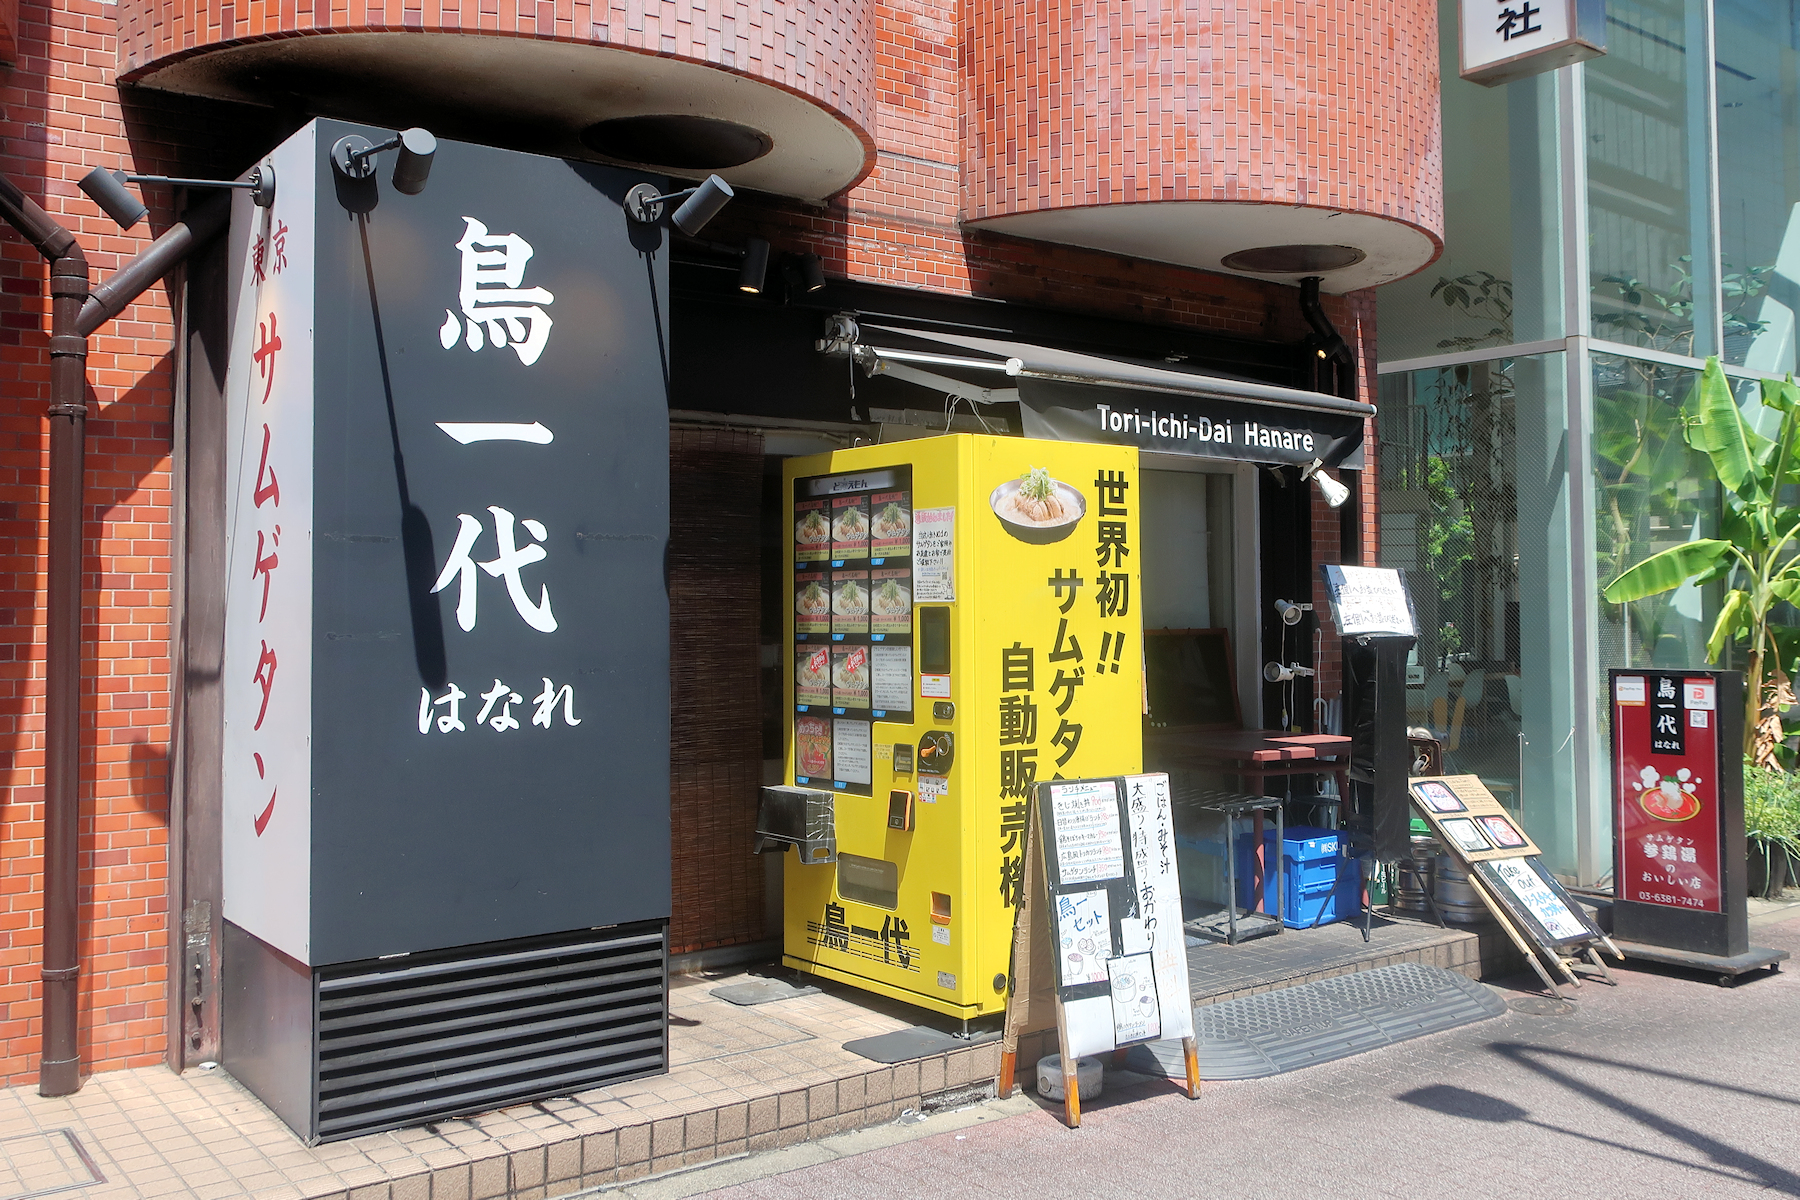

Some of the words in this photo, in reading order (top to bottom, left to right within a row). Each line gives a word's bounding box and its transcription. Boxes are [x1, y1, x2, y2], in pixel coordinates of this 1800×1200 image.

[1496, 0, 1542, 42] 社
[251, 219, 289, 287] 東京
[430, 216, 557, 634] 鳥一代
[1097, 404, 1232, 444] Tori-Ichi-Dai
[1244, 421, 1315, 452] Hanare
[833, 478, 868, 491] どえもん
[252, 311, 283, 838] サムゲタン
[1047, 568, 1085, 780] サムゲタ
[418, 678, 583, 736] はなれ
[1657, 677, 1678, 735] 鳥一代
[1654, 739, 1681, 750] はなれ
[1061, 784, 1098, 794] ランチメニュー
[1156, 780, 1171, 875] ごはん・みそ汁
[1645, 834, 1695, 846] サムゲタン
[1643, 843, 1697, 863] 参鶏湯
[1496, 863, 1520, 882] Take
[1666, 863, 1676, 874] の
[1641, 871, 1702, 890] おいしい店
[1638, 890, 1705, 908] 03-6381-7474
[1073, 910, 1102, 932] セット
